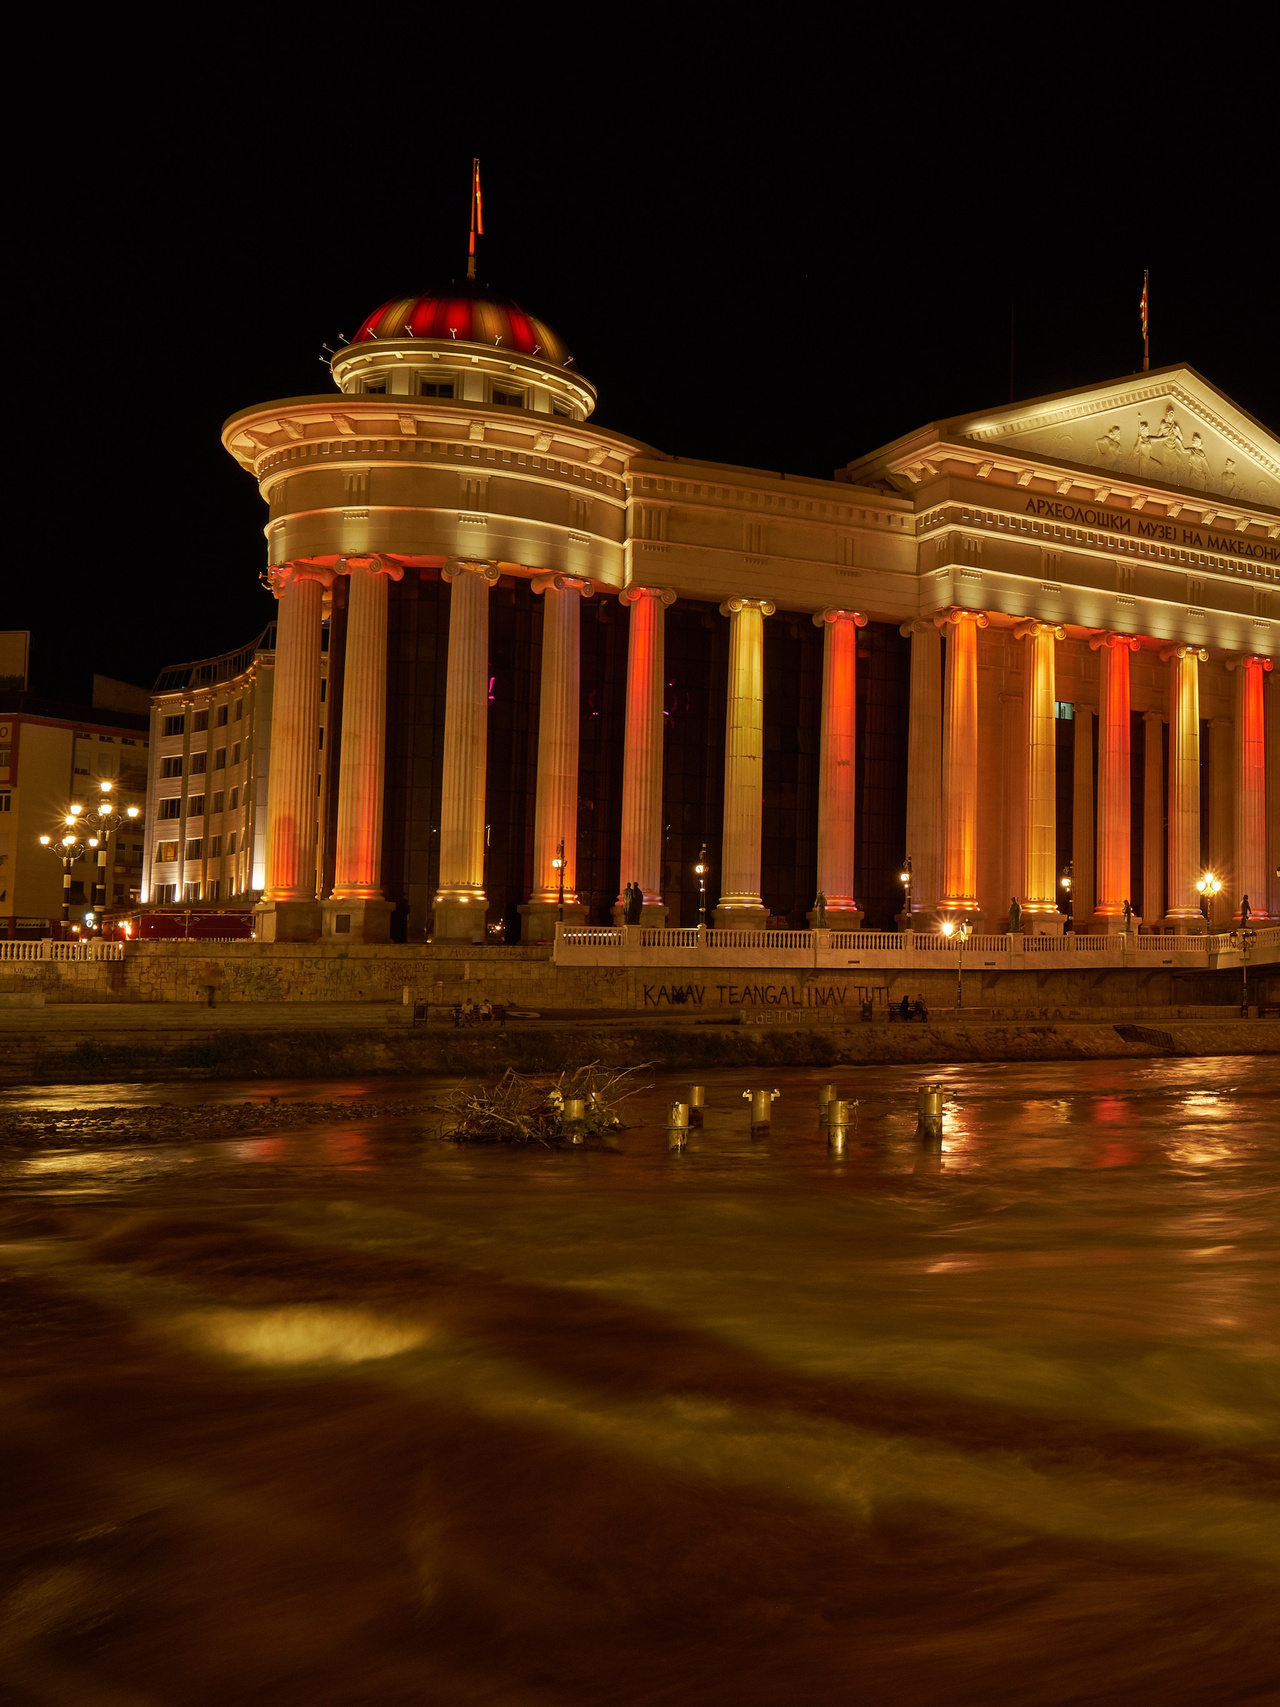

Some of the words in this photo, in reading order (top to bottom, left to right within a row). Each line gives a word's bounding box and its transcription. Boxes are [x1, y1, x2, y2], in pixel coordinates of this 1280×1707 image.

[1025, 498, 1131, 532] АРХЕОЛОШКИ
[1137, 521, 1177, 542] МУЗЕЈ
[1182, 529, 1203, 547] НА
